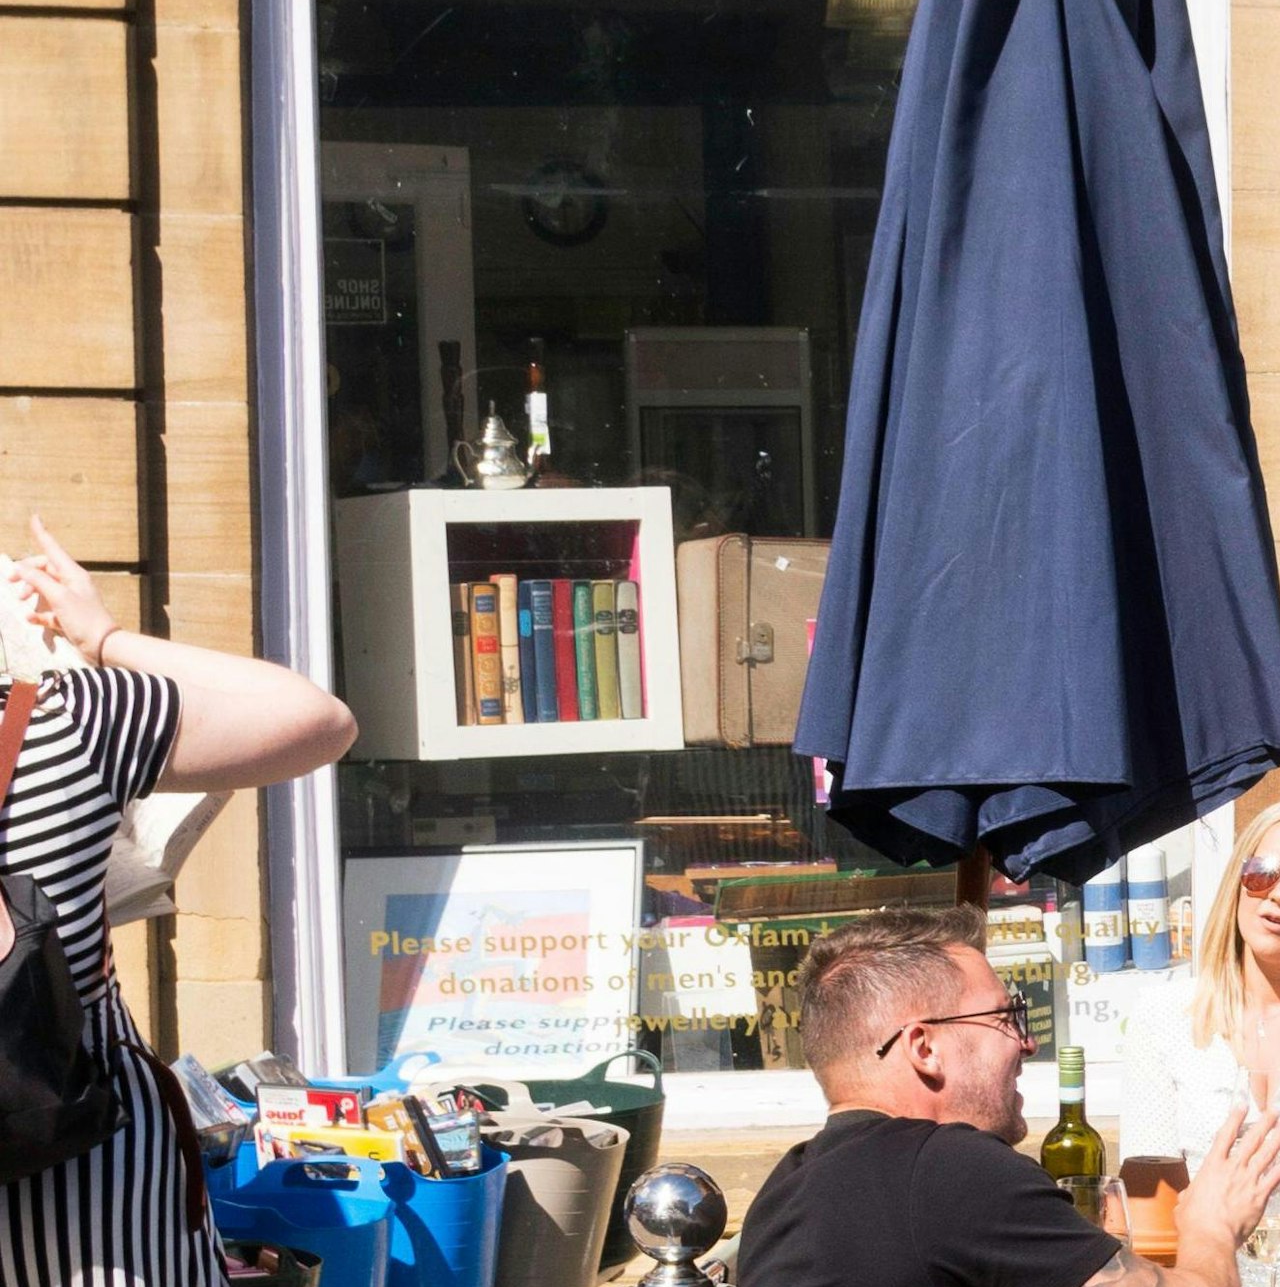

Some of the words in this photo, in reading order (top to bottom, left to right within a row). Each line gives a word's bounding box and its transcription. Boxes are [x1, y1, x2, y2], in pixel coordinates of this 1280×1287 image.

[370, 930, 472, 956] Please
[485, 931, 608, 958] support
[621, 930, 690, 956] your
[704, 922, 810, 947] Oxfam
[1055, 913, 1160, 944] quality
[439, 972, 594, 995] donations
[607, 968, 638, 991] of
[647, 965, 736, 989] men's
[614, 1006, 760, 1036] jewellery
